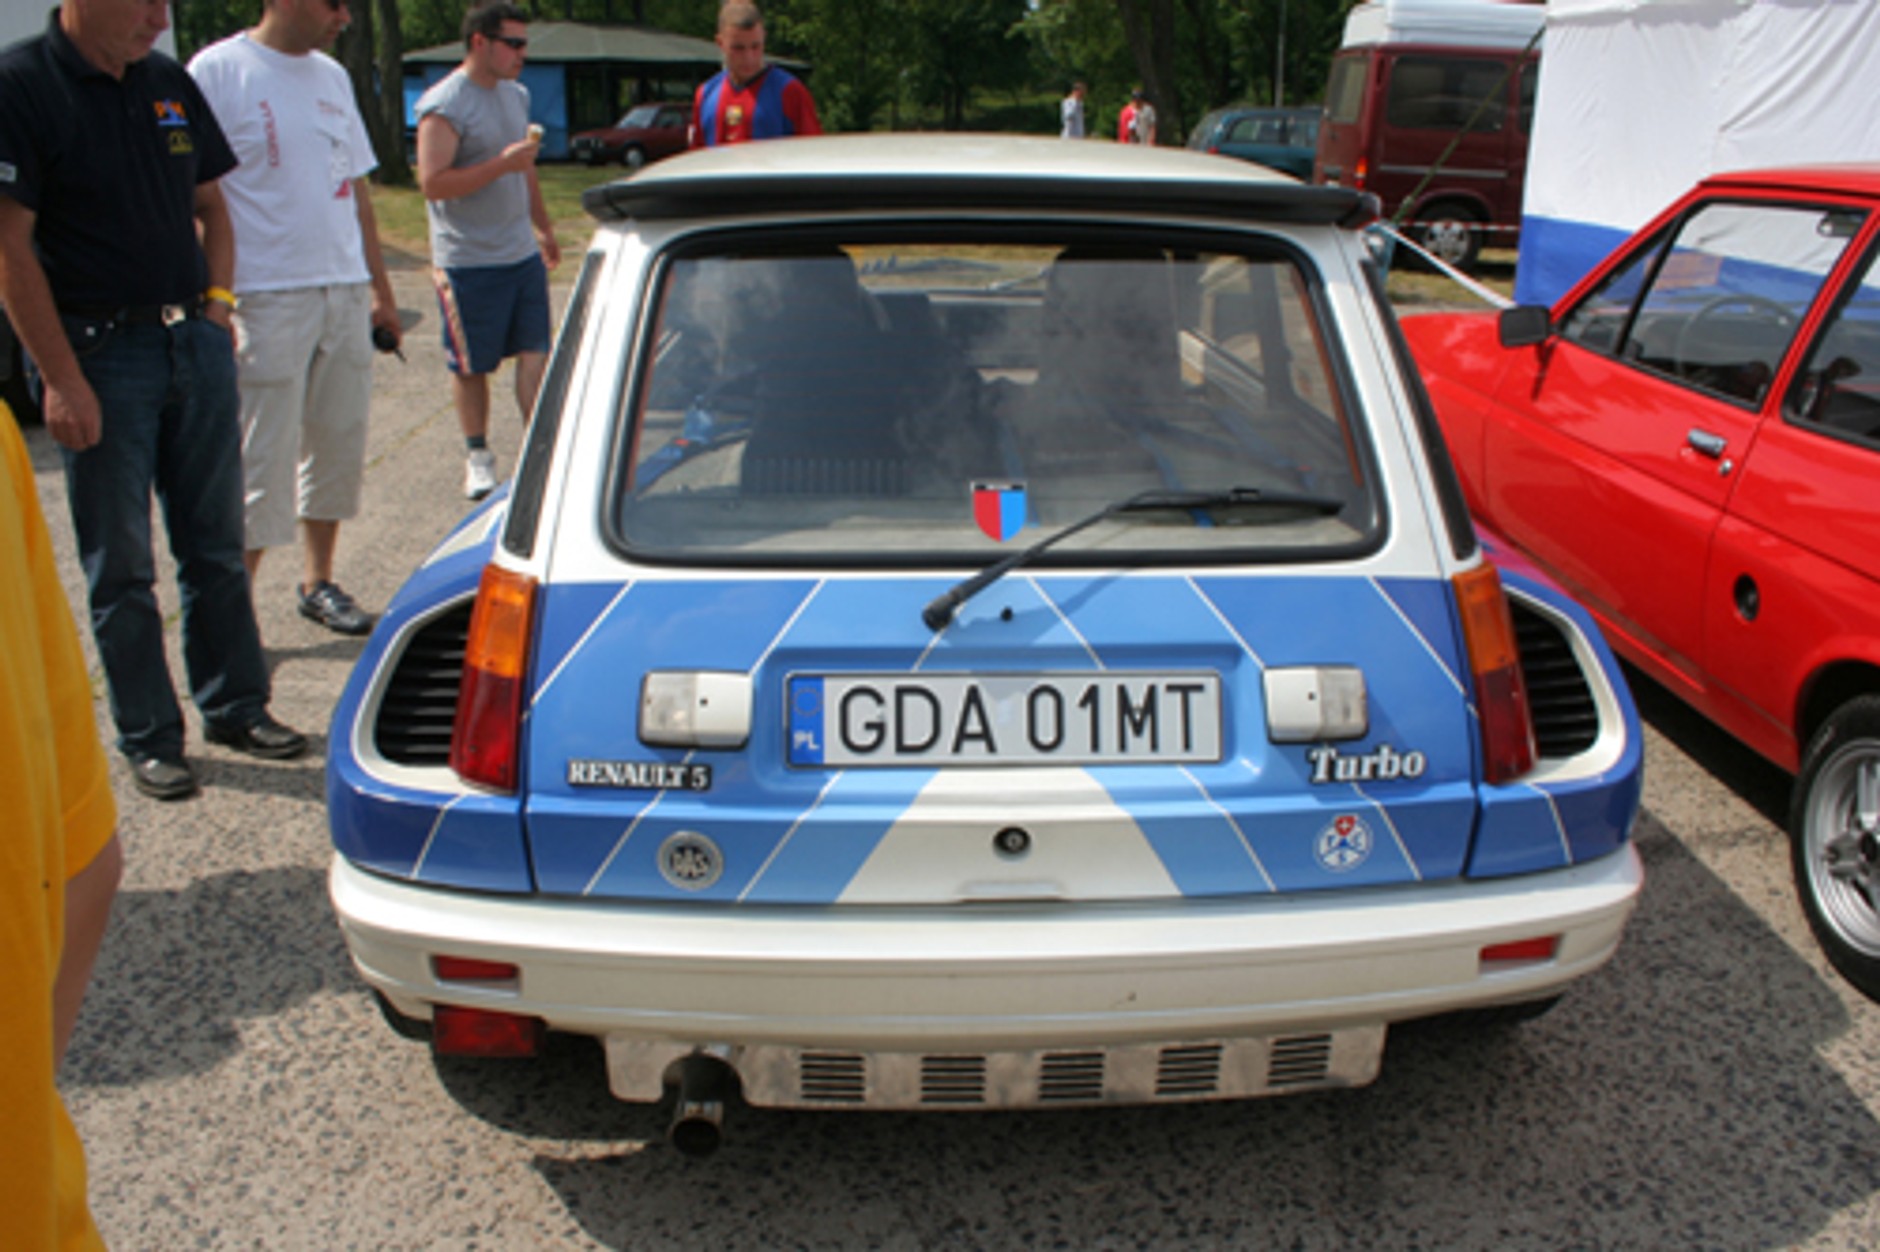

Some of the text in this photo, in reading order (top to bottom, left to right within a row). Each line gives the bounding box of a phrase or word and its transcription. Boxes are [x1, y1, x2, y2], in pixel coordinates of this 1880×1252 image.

[838, 683, 1206, 755] GDA 01MT
[793, 730, 821, 751] PL
[568, 761, 709, 789] RENAULT 5
[1310, 745, 1427, 782] Turbo
